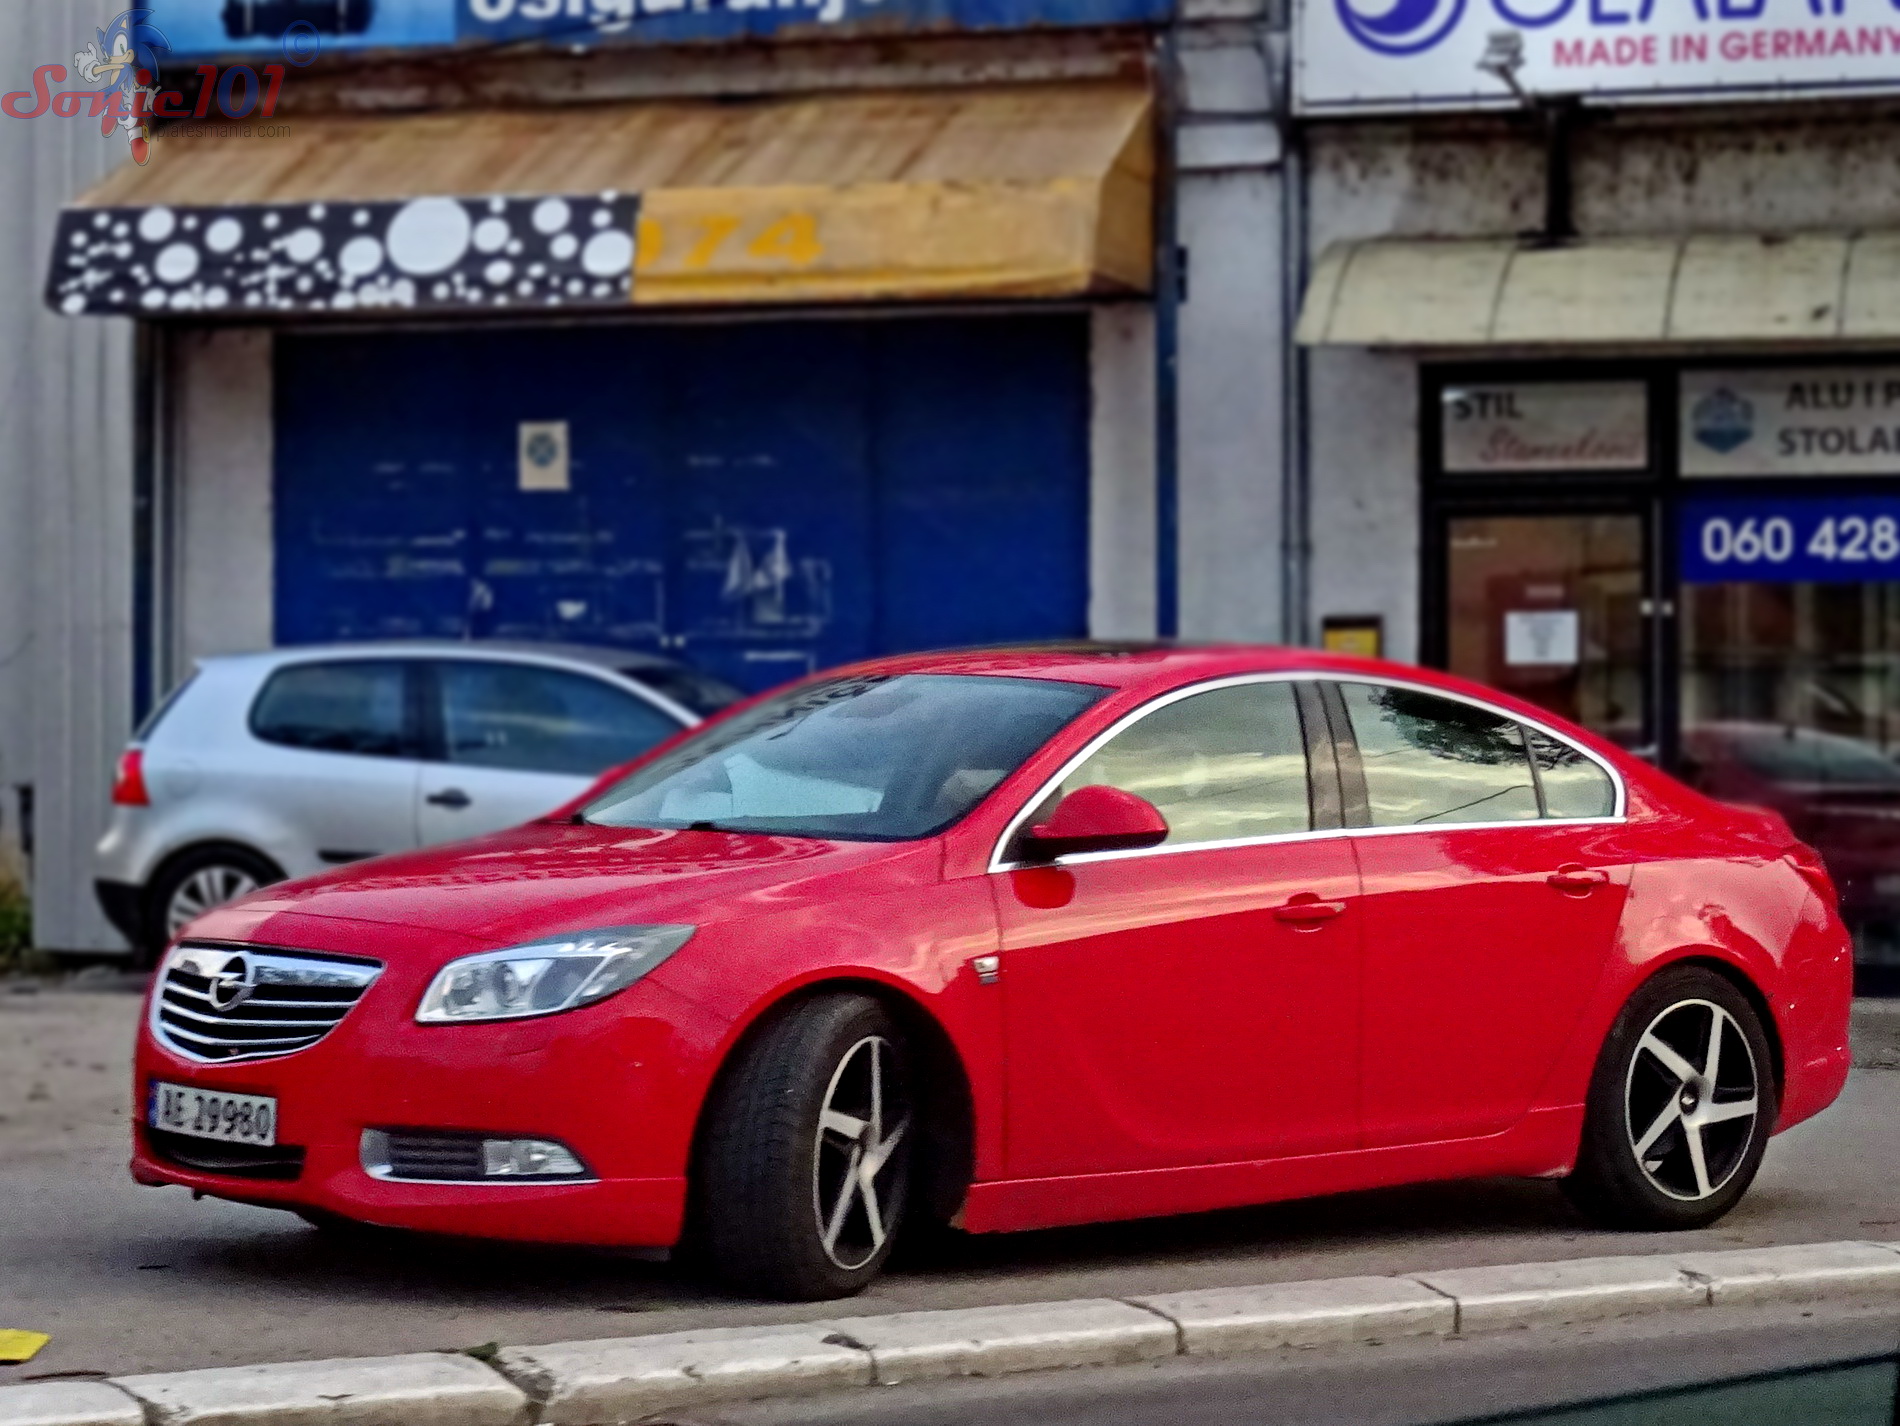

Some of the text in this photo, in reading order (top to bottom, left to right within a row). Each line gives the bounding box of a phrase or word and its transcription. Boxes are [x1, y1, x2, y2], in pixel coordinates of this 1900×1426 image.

[1554, 27, 1900, 67] MADE IN GERMANY
[1453, 391, 1523, 421] STIL
[1785, 381, 1855, 410] ALU
[1863, 380, 1874, 409] I
[1777, 425, 1900, 456] STOLA
[1701, 515, 1900, 563] 060 428
